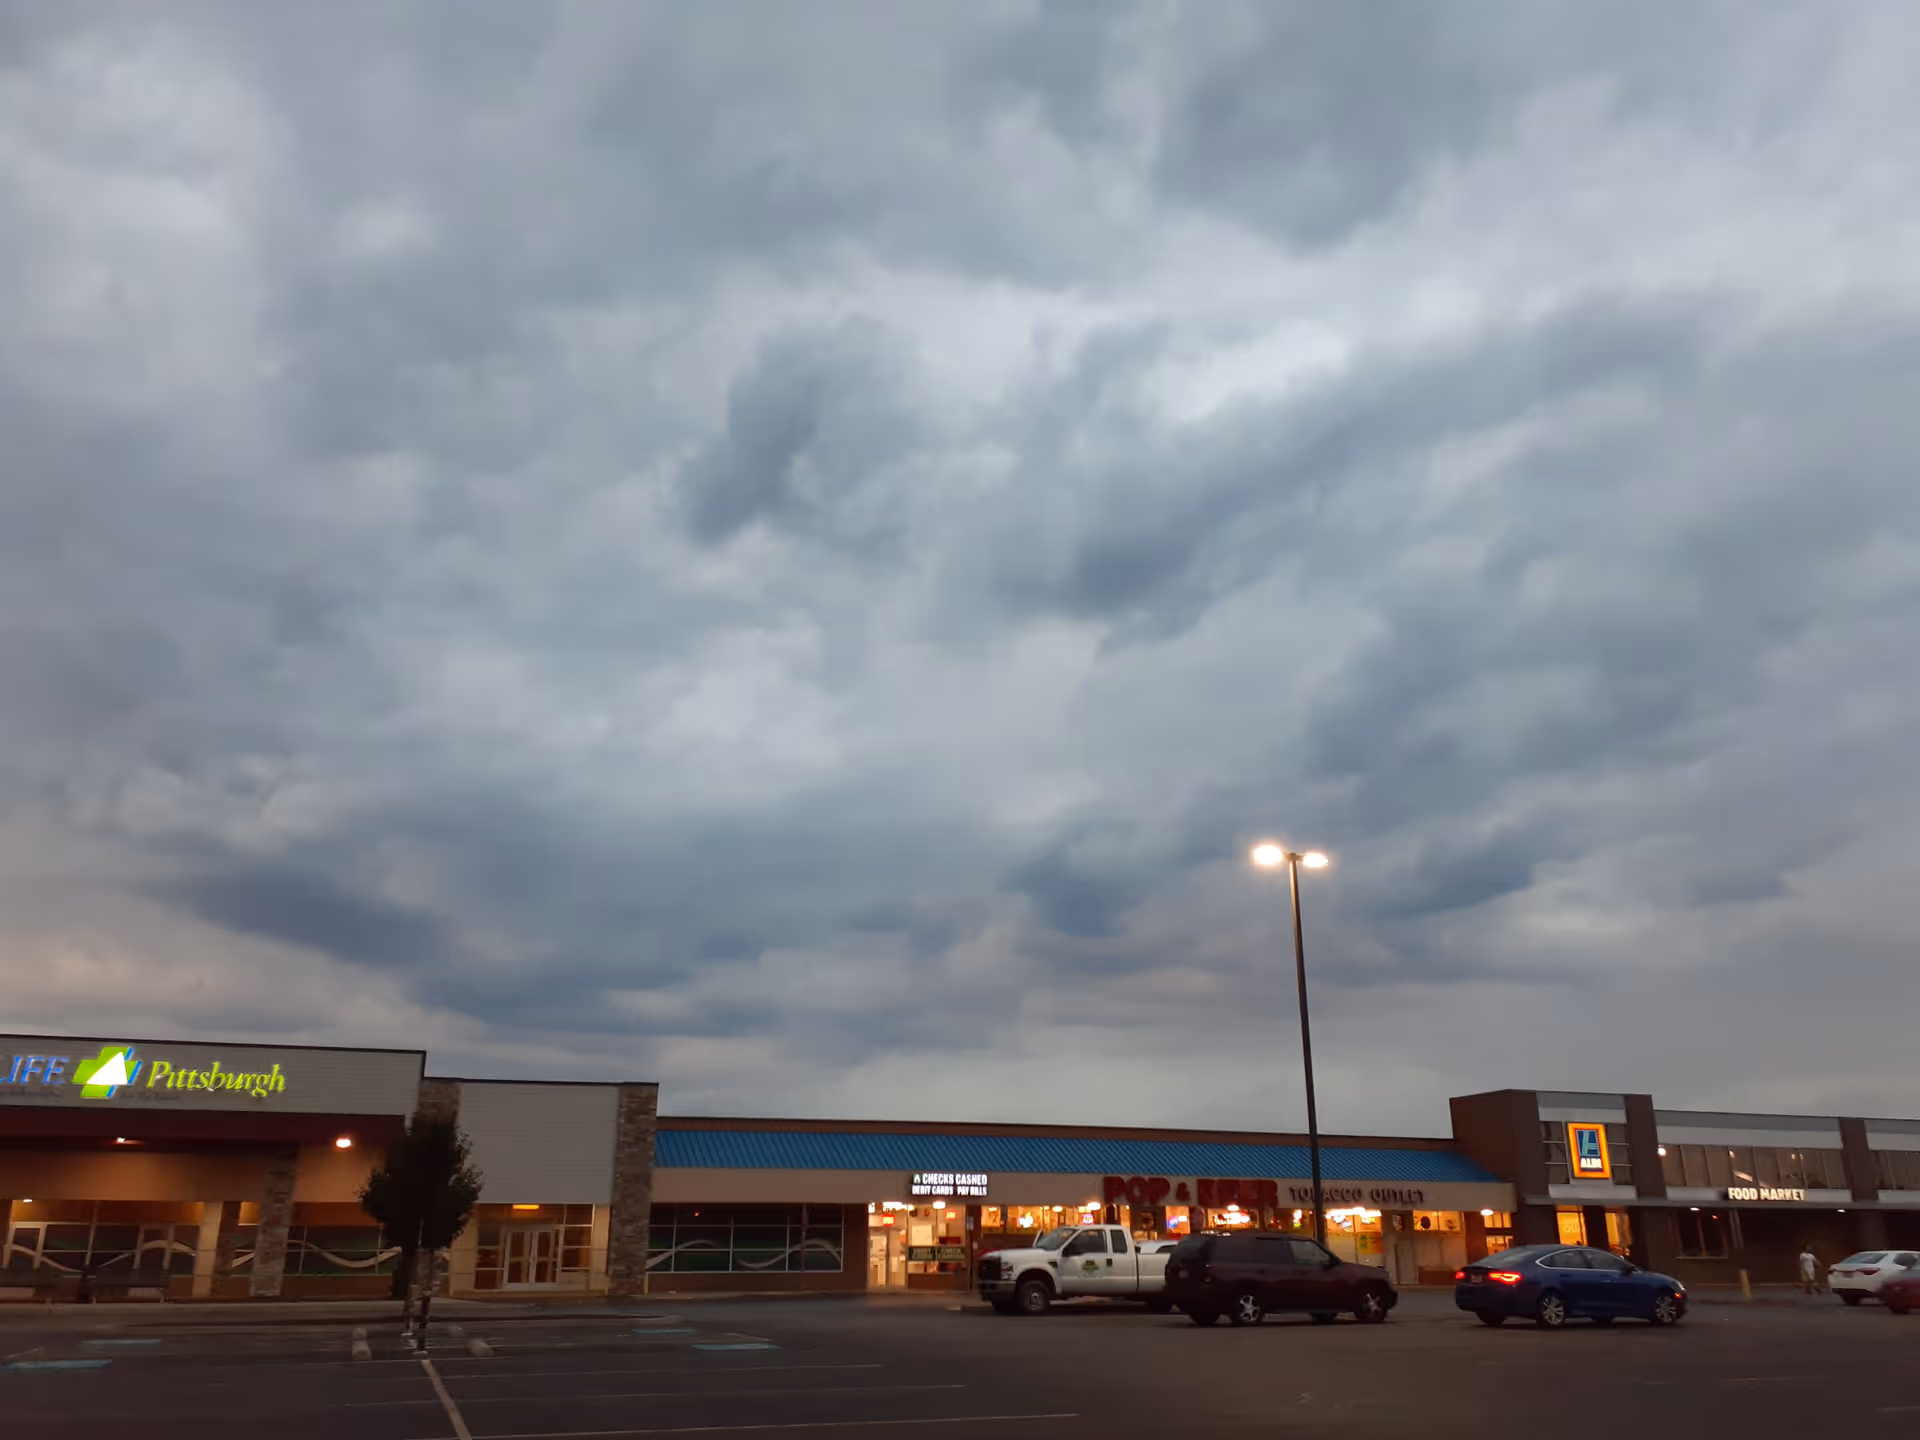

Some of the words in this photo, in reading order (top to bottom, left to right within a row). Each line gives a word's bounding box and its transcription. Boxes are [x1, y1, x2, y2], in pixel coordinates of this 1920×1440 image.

[0, 1056, 68, 1085] IFE
[147, 1060, 286, 1098] Pittsburgh
[922, 1173, 954, 1185] CHECKS
[955, 1174, 988, 1185] CASHED
[932, 1185, 954, 1196] CARDS
[957, 1186, 970, 1196] PAY
[1289, 1187, 1362, 1203] TOACCO
[1370, 1188, 1424, 1204] OUTLET
[1728, 1187, 1758, 1200] FOOD
[1760, 1188, 1805, 1200] MARKET
